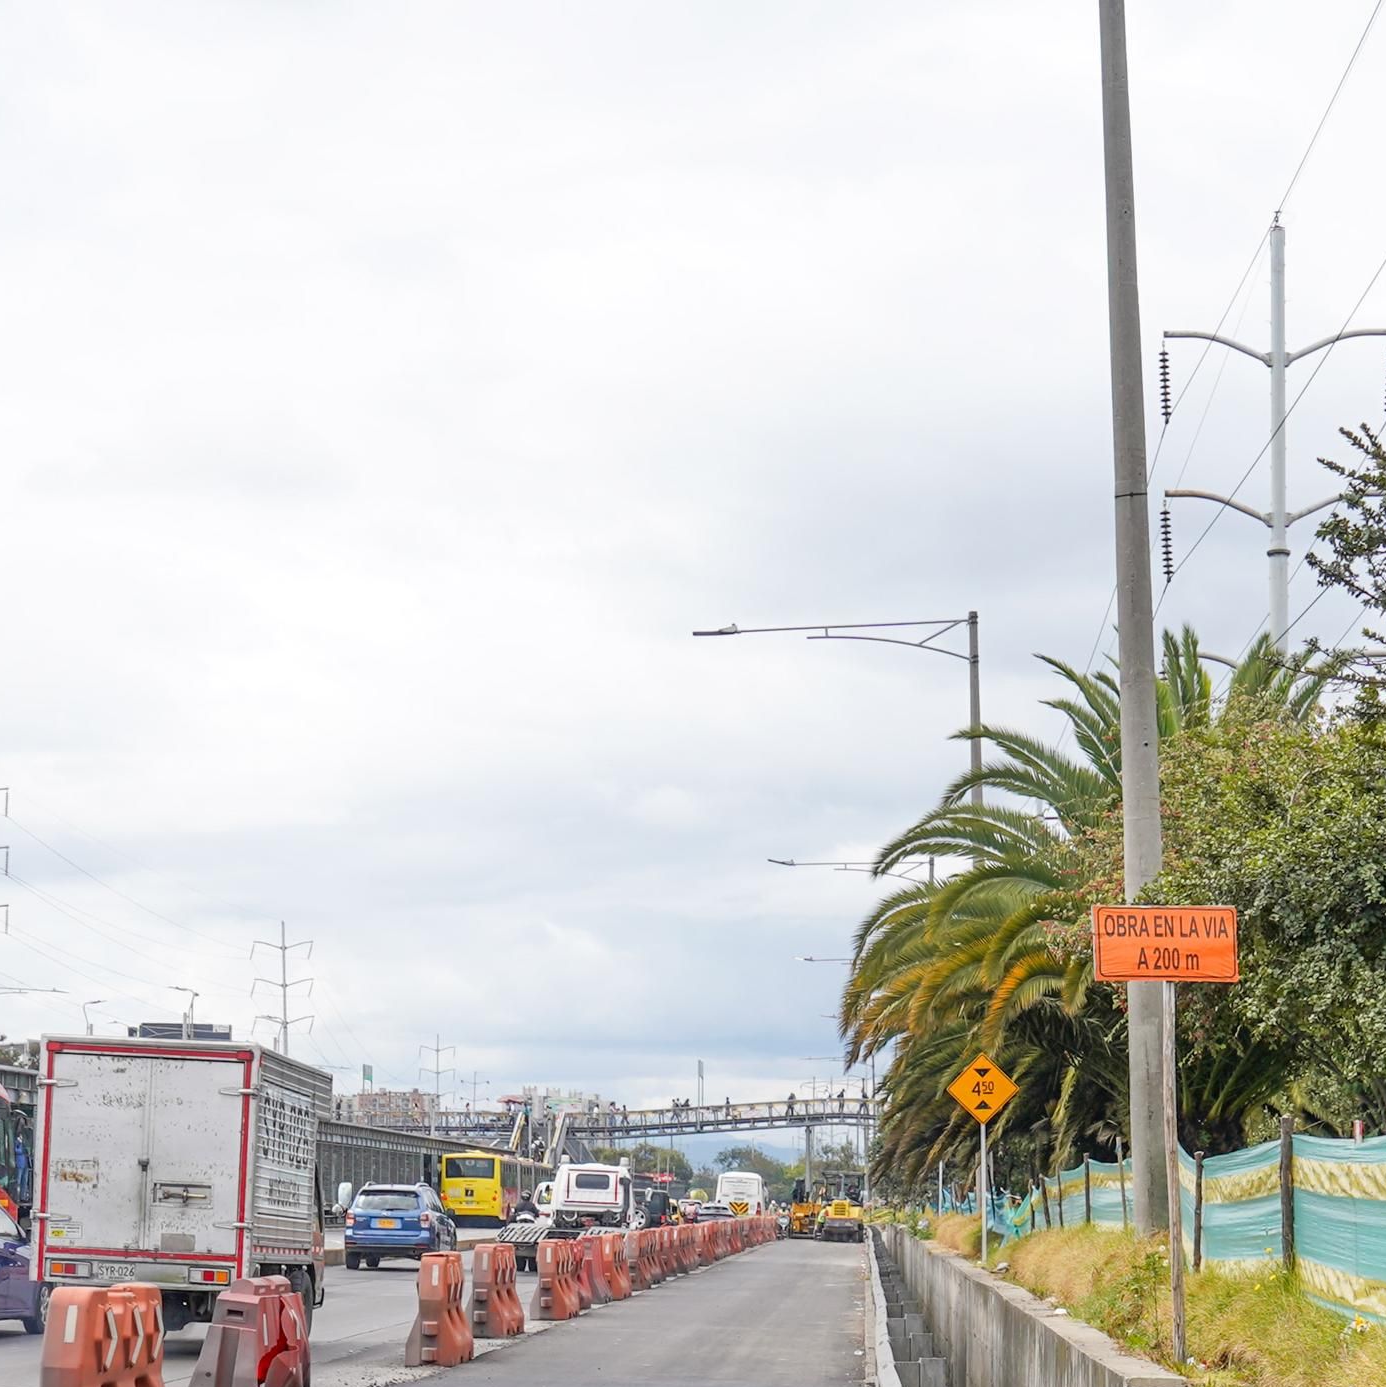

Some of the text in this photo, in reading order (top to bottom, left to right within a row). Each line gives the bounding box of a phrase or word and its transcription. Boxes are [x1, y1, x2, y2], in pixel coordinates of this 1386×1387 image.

[1104, 914, 1229, 939] OBRA EN LA VIA
[1137, 947, 1200, 970] A 200 m
